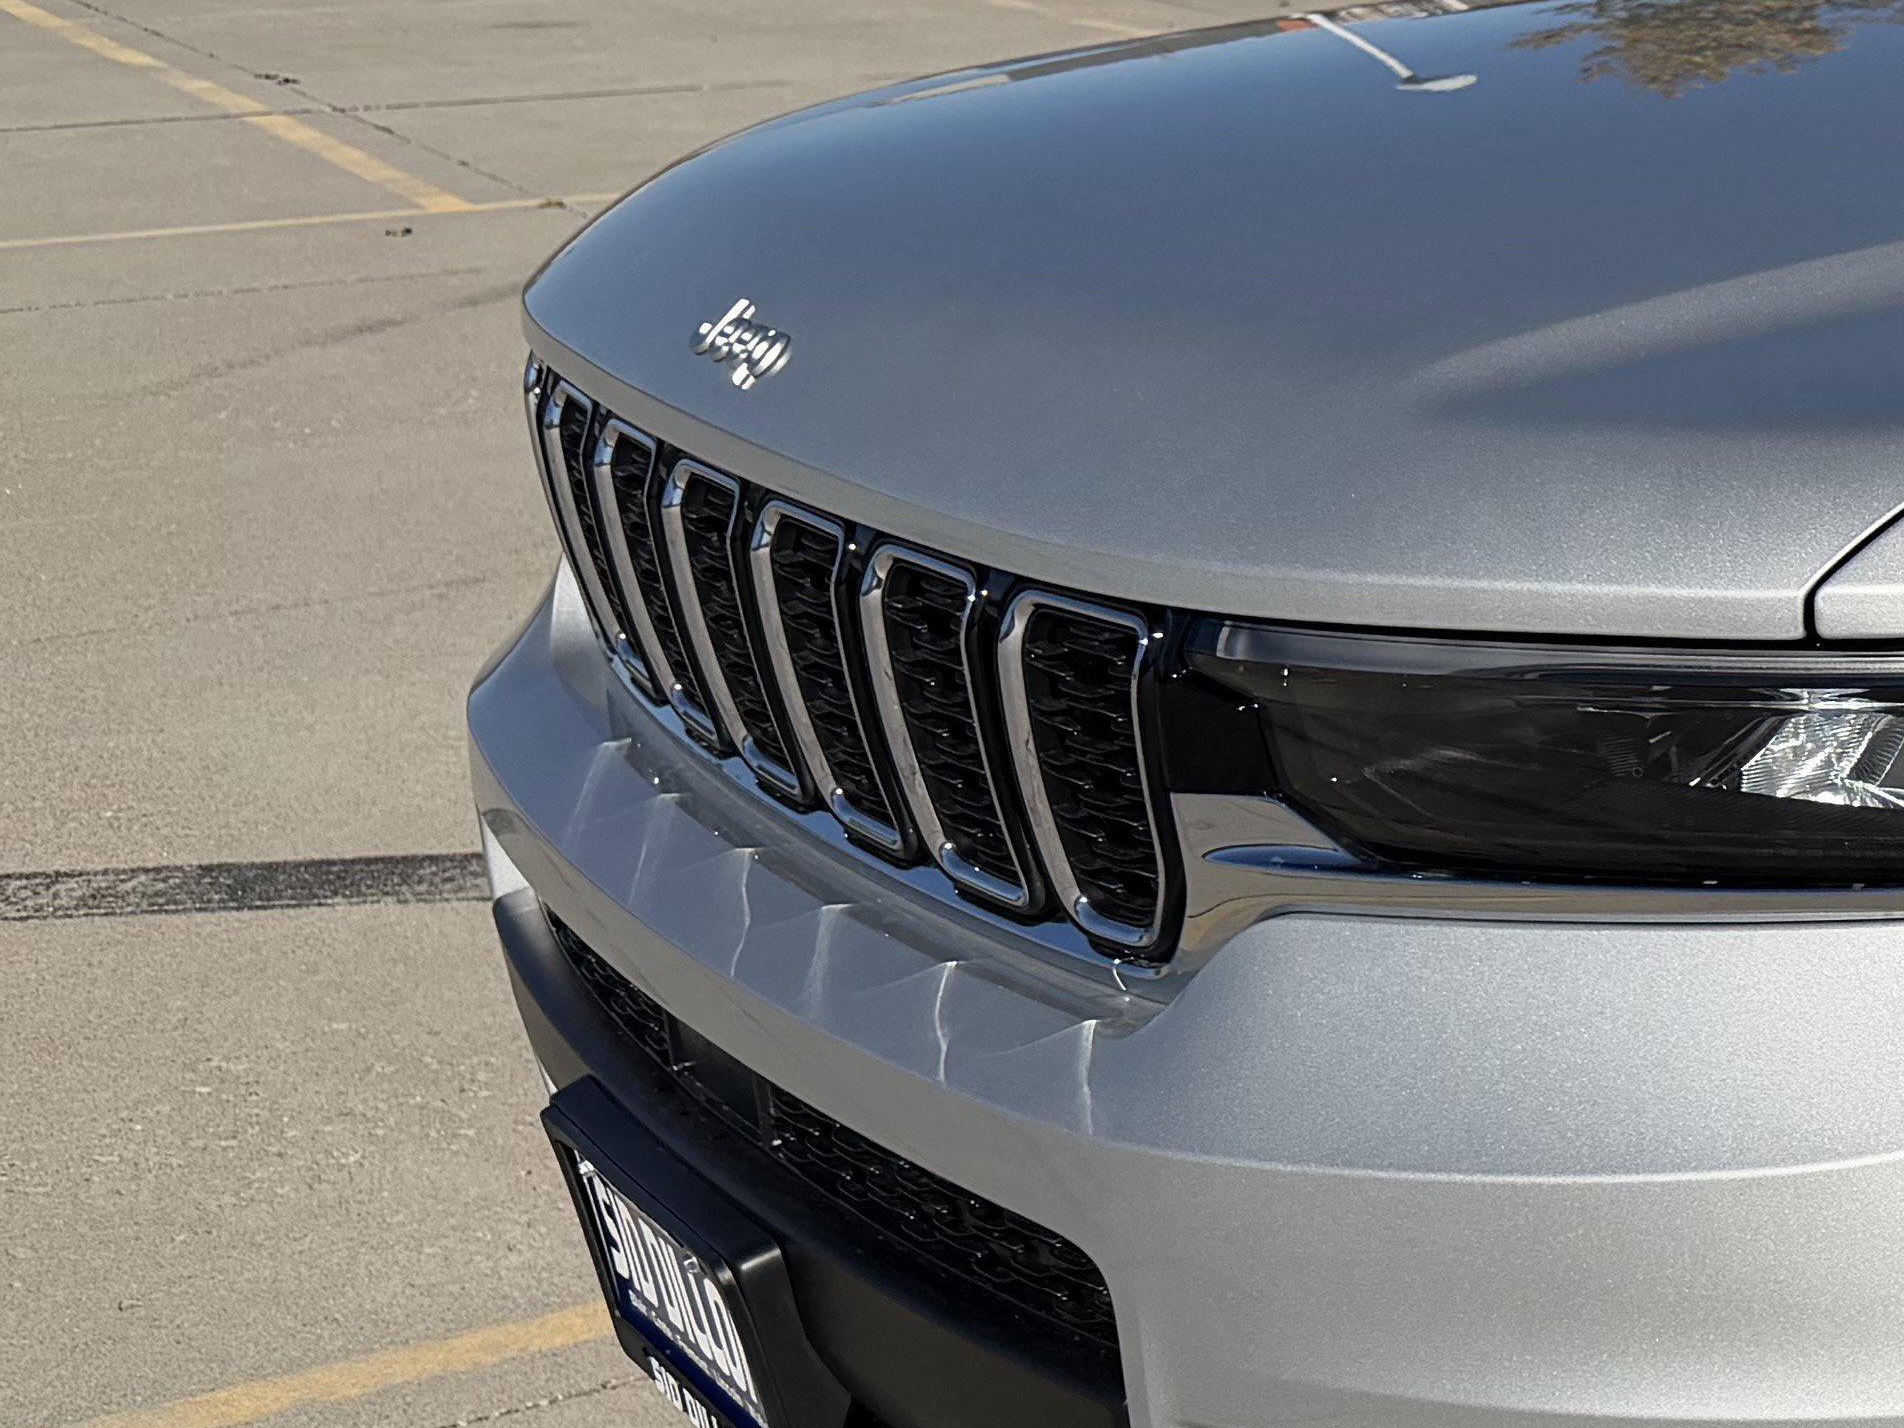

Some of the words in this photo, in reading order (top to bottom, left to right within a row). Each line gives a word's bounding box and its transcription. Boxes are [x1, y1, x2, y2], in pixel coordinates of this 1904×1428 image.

[689, 297, 792, 390] Jeep
[593, 1172, 658, 1307] SID
[649, 1355, 683, 1413] SID
